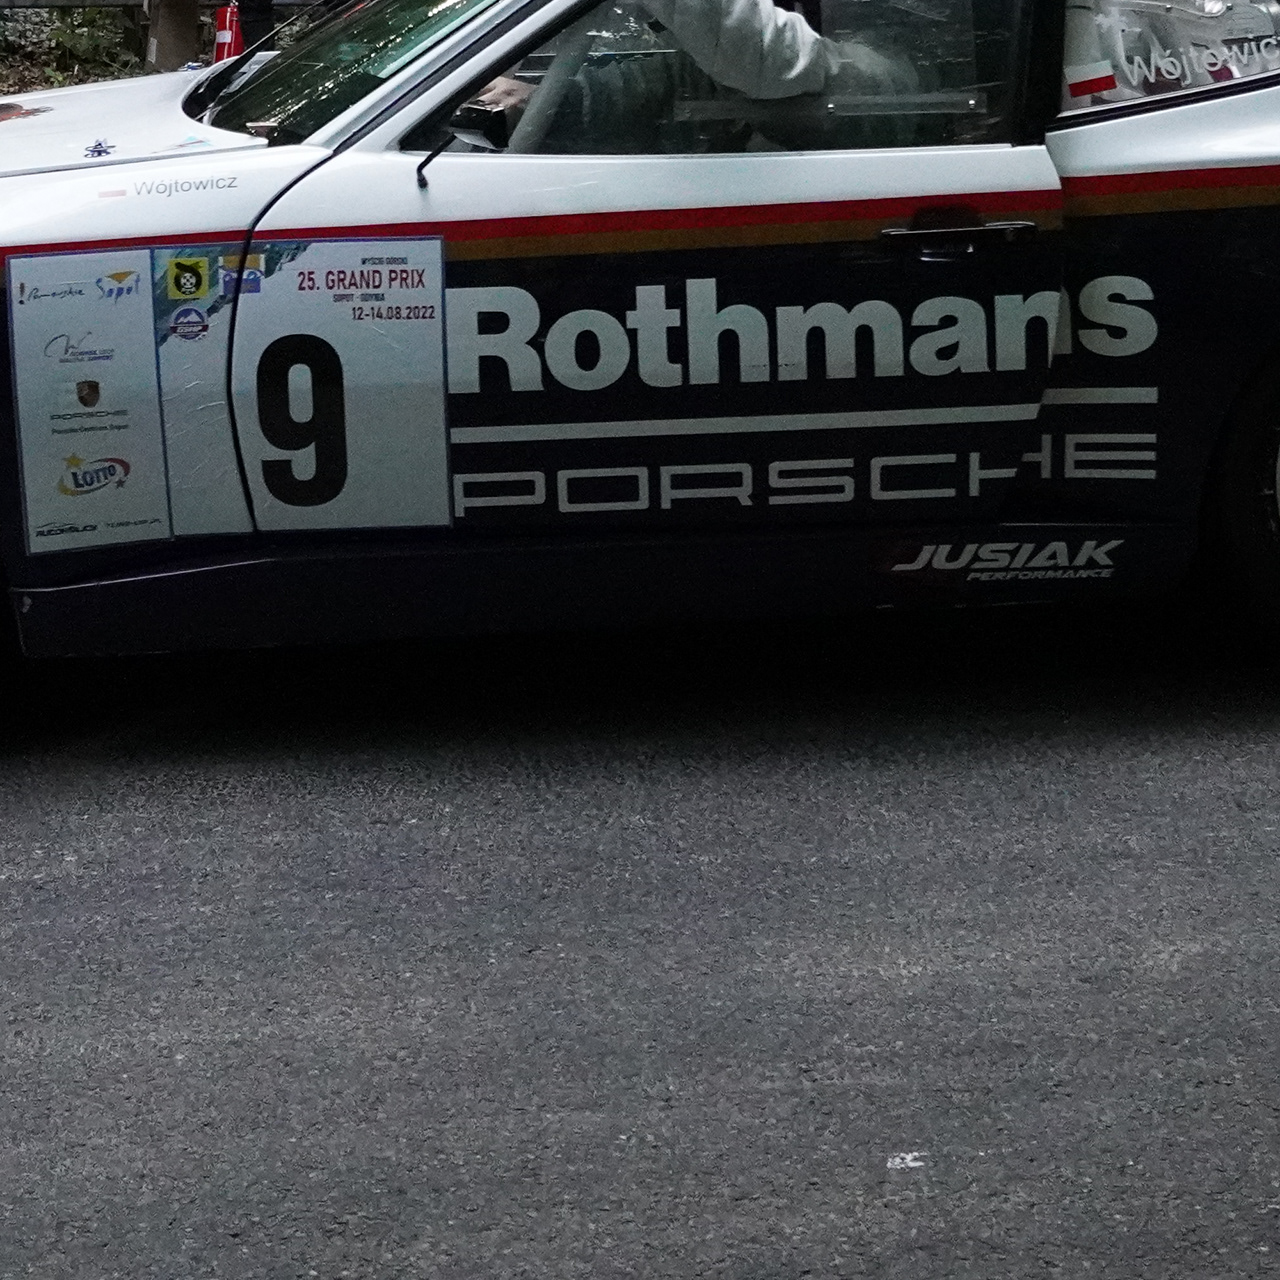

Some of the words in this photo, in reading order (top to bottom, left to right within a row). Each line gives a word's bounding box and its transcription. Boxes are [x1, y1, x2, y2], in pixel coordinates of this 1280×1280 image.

[133, 176, 238, 197] Wójtowicz
[297, 271, 320, 291] 25.
[325, 269, 383, 291] GRAND
[388, 268, 426, 289] PRIX
[351, 305, 436, 321] 12-14.08.2022
[448, 275, 1159, 394] Rothmans
[256, 333, 349, 507] 9
[70, 464, 117, 489] LOTTO
[452, 433, 1159, 517] PORSCHE
[890, 540, 1125, 571] JUSIAK
[966, 568, 1115, 581] PERFORMANCE
